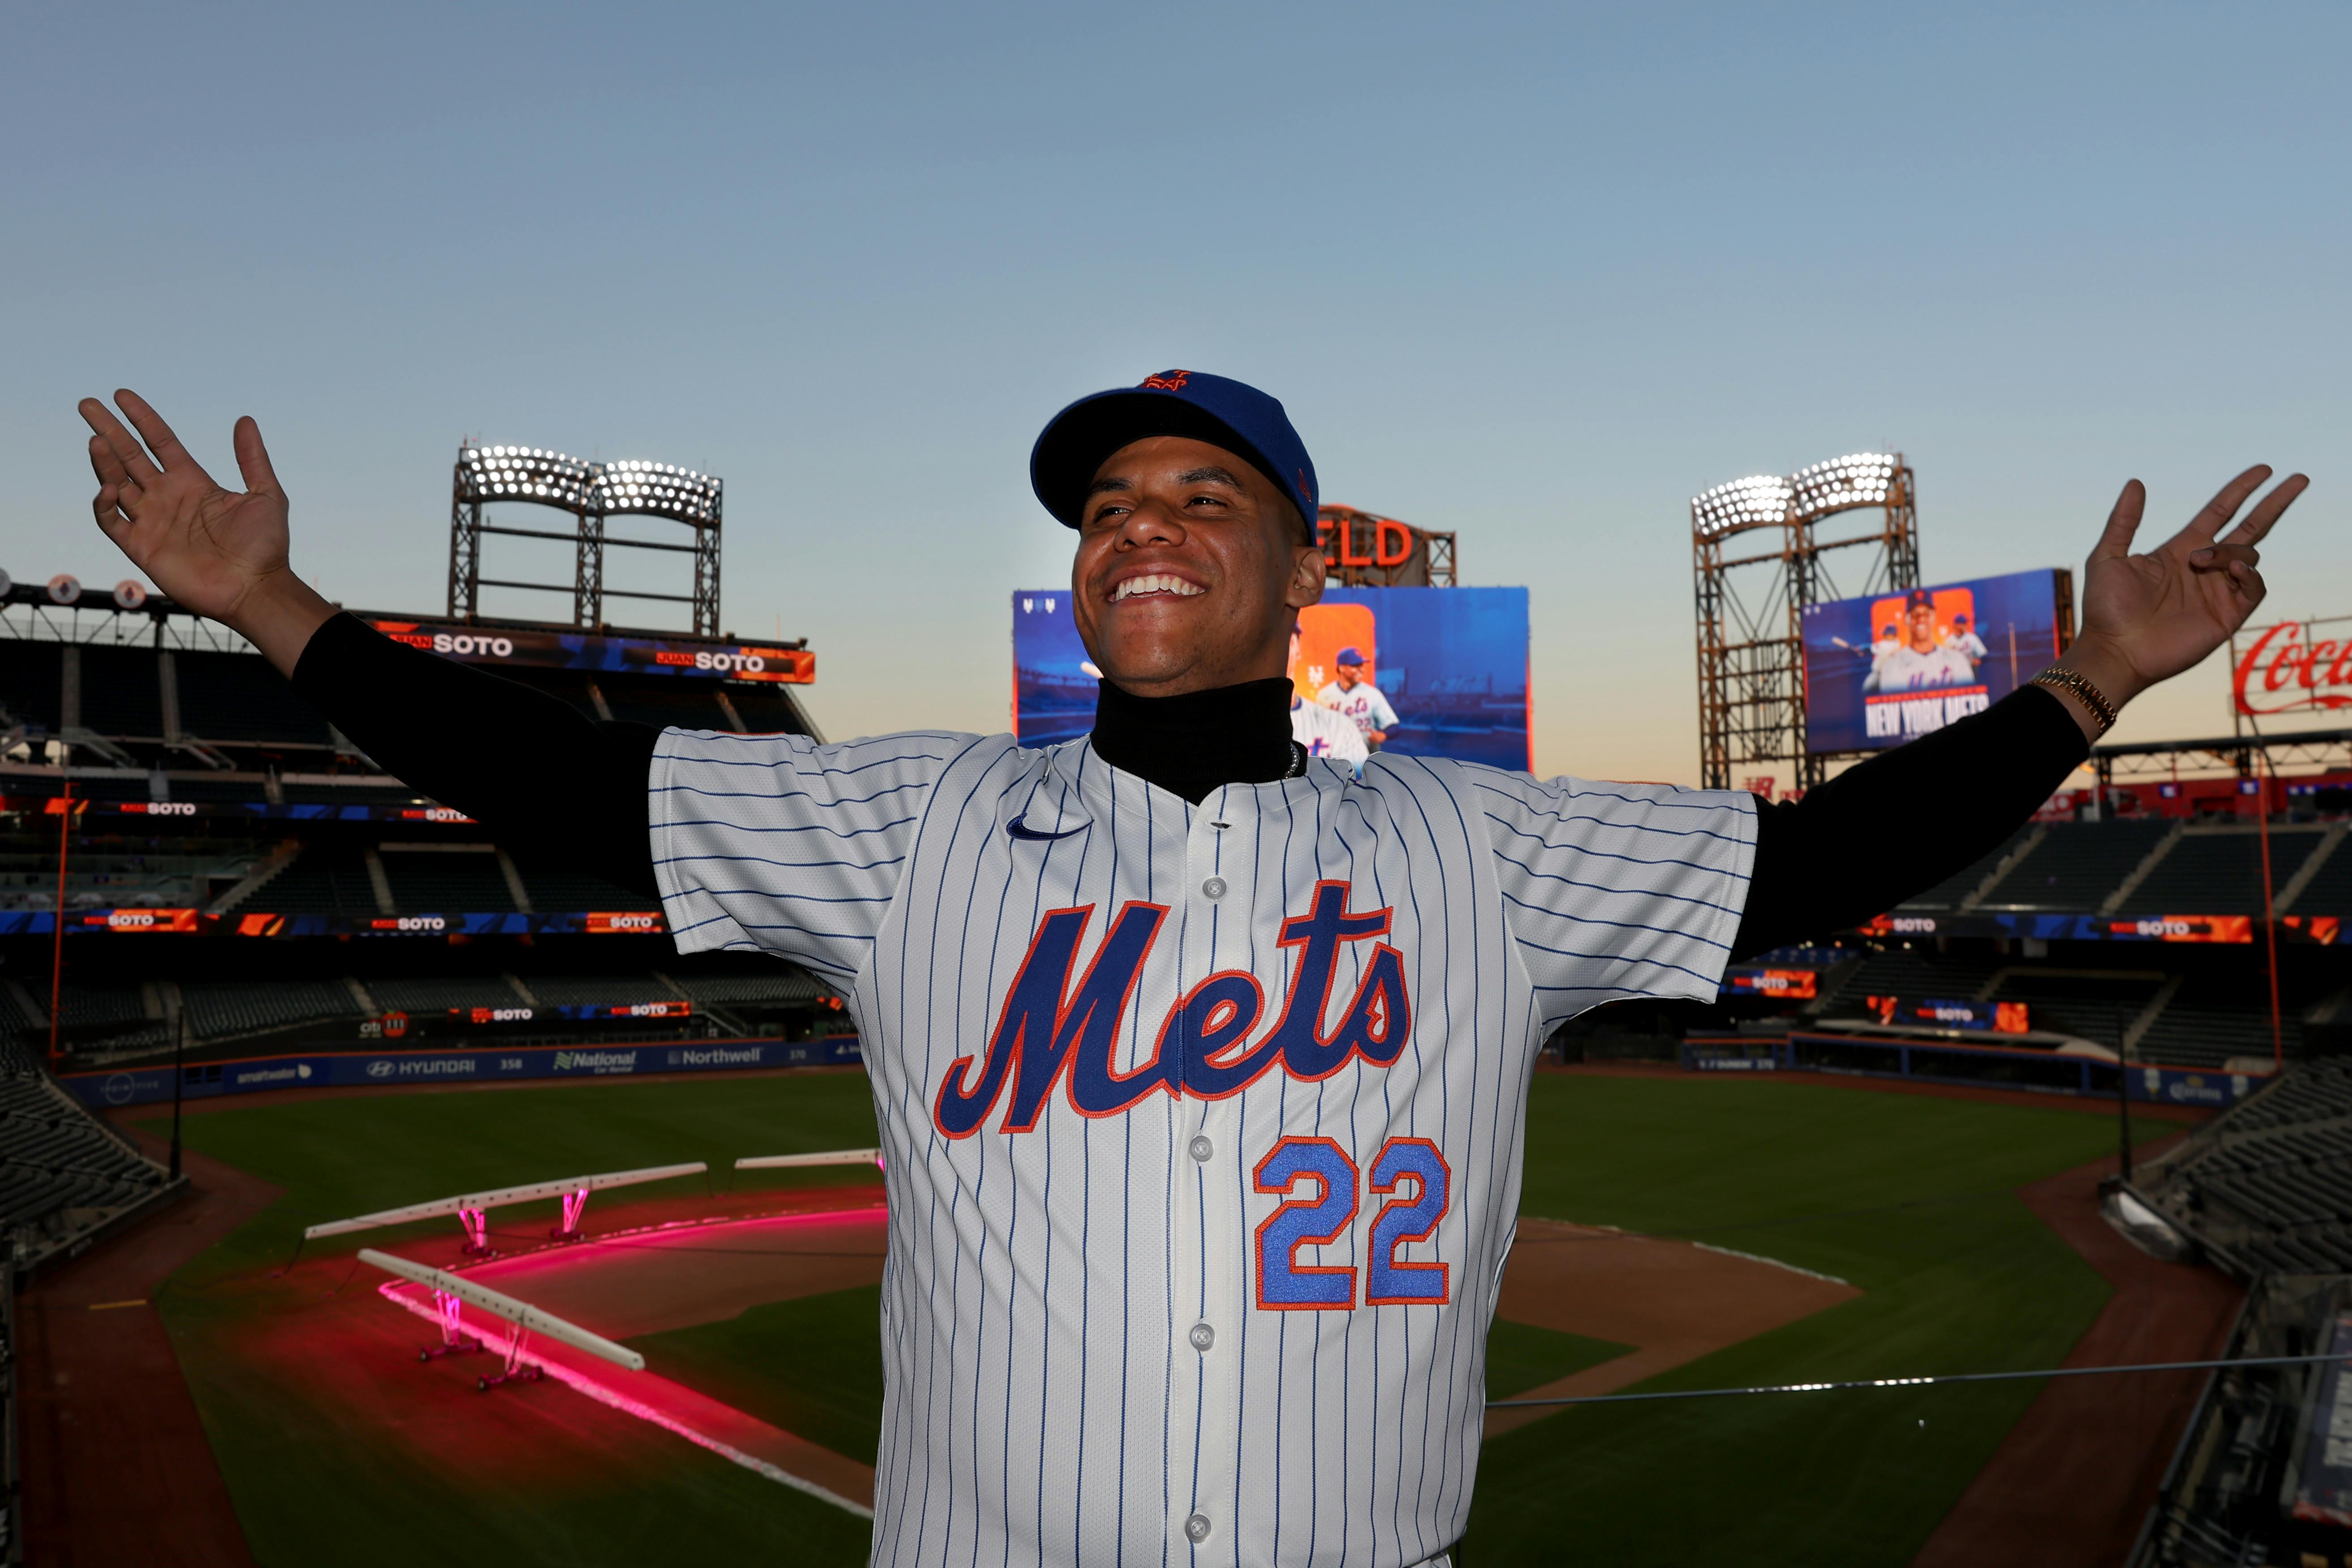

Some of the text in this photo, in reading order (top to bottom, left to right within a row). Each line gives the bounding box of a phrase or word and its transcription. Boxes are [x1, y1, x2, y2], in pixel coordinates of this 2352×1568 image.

[433, 633, 513, 657] SOTO
[658, 651, 765, 673] JUAN SOTO
[147, 802, 196, 816] SOTO
[107, 914, 155, 927] SOTO
[397, 917, 446, 931] SOTO
[609, 915, 653, 928] SOTO
[1892, 918, 1937, 933] SOTO
[2136, 920, 2191, 937] SOTO
[1751, 975, 1788, 990] SOTO
[492, 1008, 533, 1021] SOTO
[630, 1004, 668, 1017] SOTO
[933, 879, 1411, 1140] Mets
[572, 1050, 637, 1068] National
[682, 1047, 761, 1065] Northwell
[399, 1059, 475, 1075] HYUNDAI
[1252, 1135, 1451, 1311] 22
